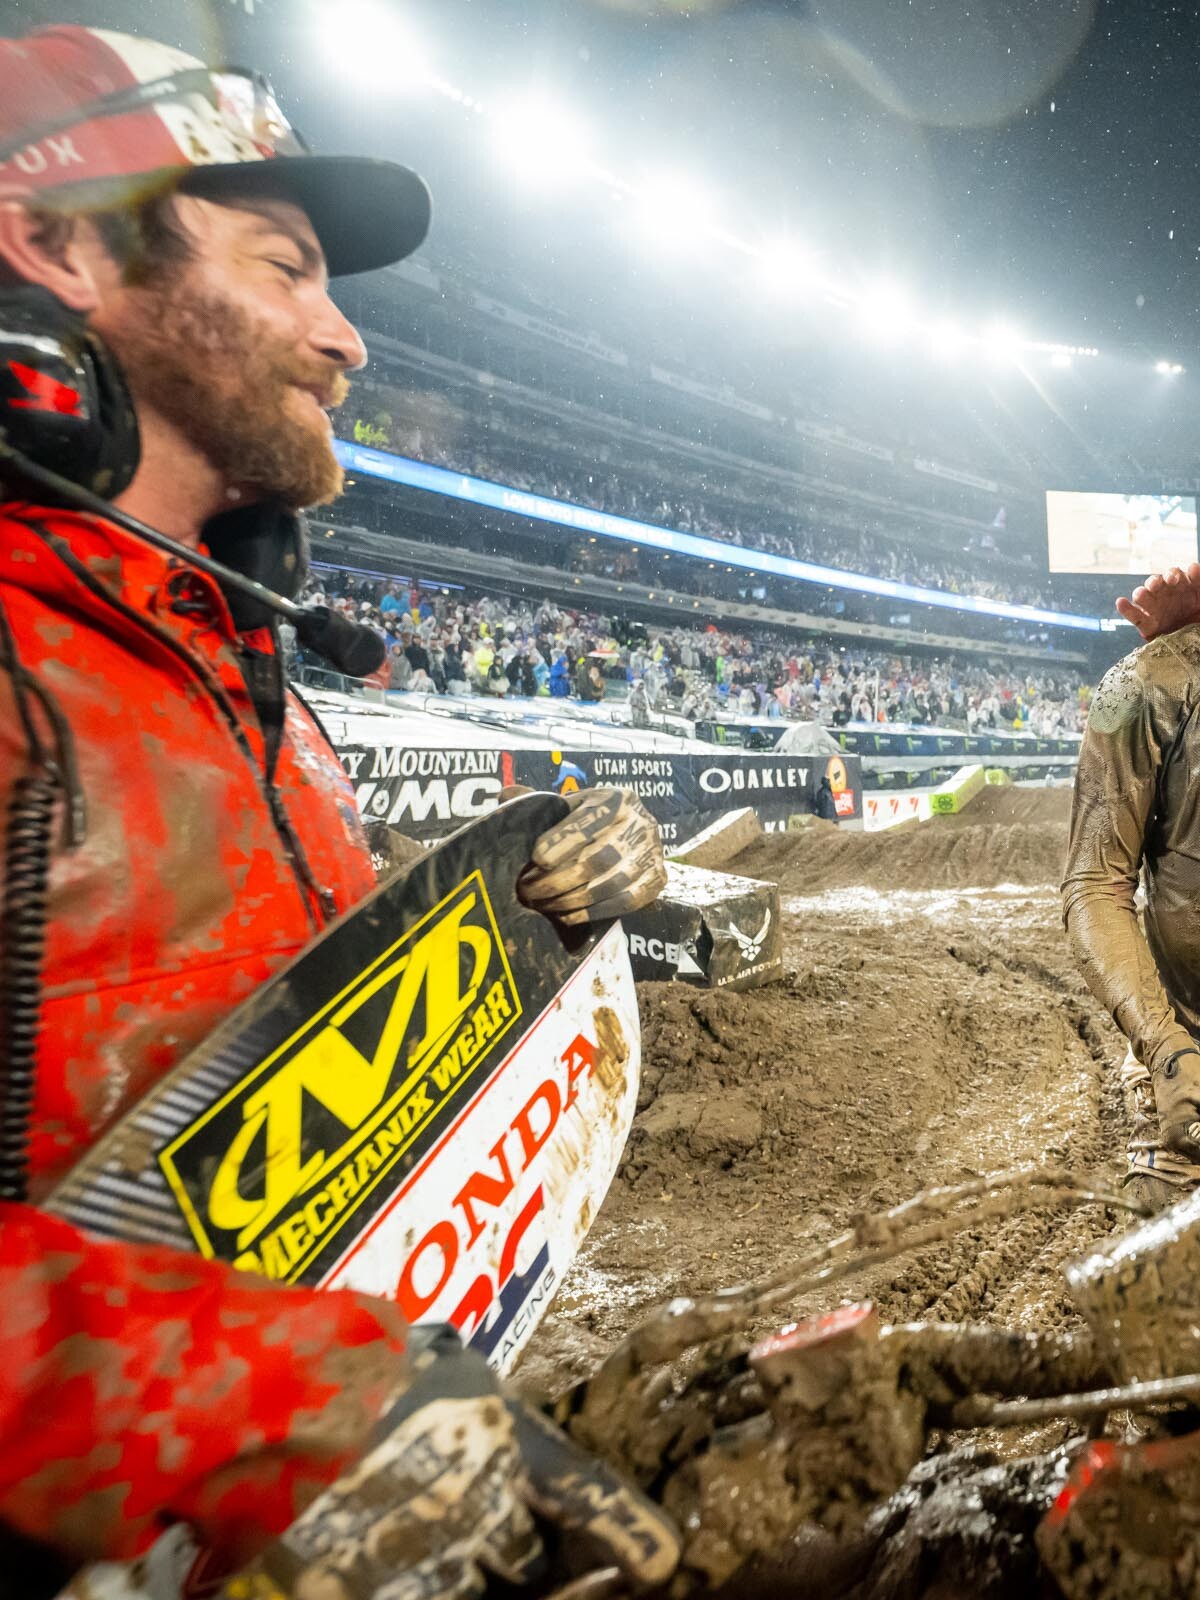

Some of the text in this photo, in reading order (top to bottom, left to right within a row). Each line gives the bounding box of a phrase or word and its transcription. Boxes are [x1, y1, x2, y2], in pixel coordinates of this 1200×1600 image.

[0, 135, 86, 175] OX
[369, 747, 500, 779] MOUNTAIN
[594, 758, 673, 777] UTAH SPORTS
[731, 768, 809, 789] OAKLEY
[234, 979, 513, 1284] MECHANIX WEAR
[385, 1033, 602, 1324] ONDA
